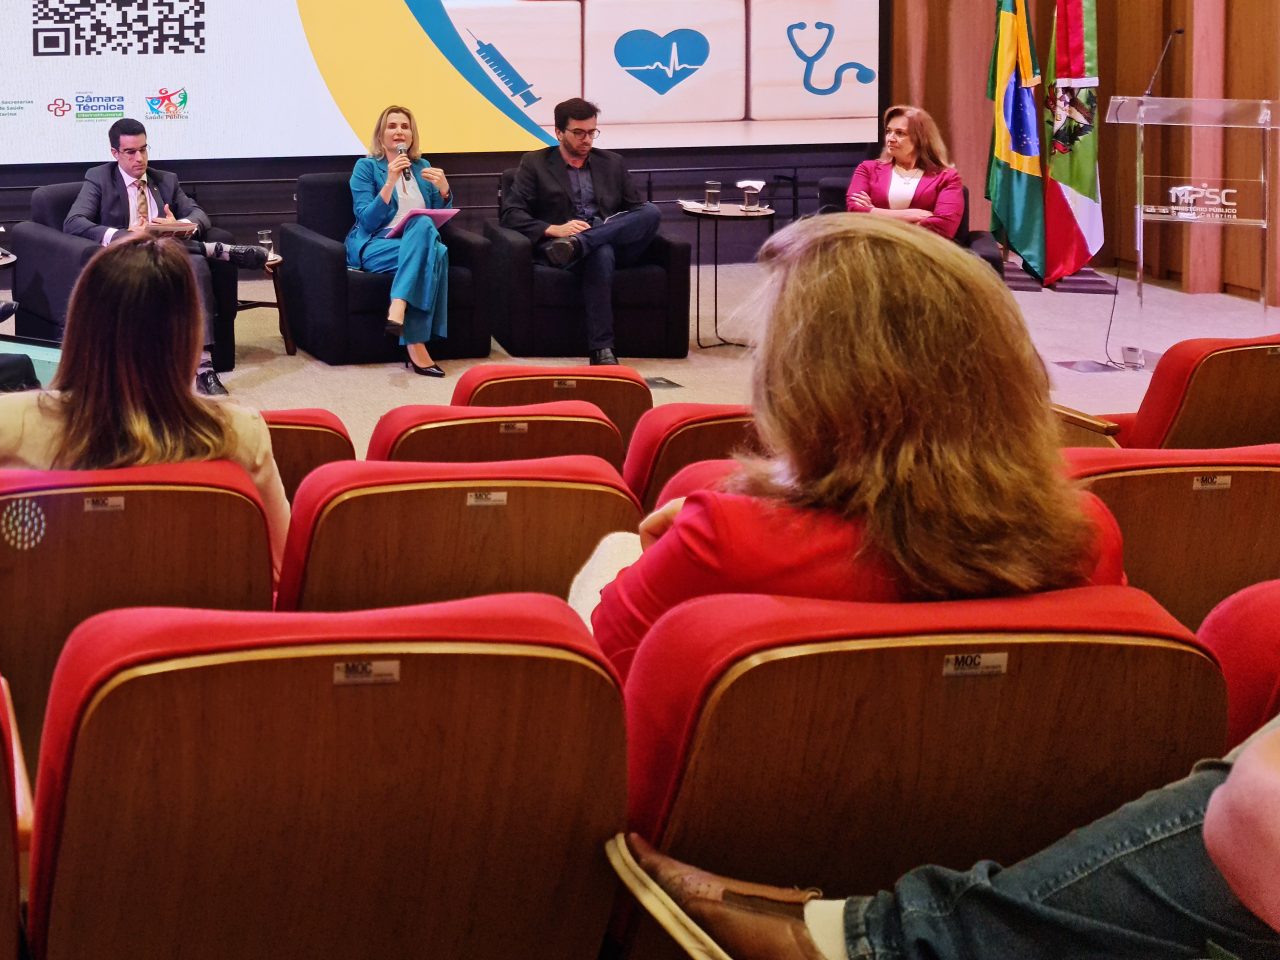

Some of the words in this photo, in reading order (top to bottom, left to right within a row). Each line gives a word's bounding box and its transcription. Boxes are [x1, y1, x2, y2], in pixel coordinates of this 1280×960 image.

[75, 95, 124, 103] Câmara
[76, 103, 124, 111] Técnica
[1170, 186, 1237, 206] MPSC
[1201, 476, 1217, 484] MOC
[955, 654, 982, 667] MOC
[345, 662, 372, 675] MOC
